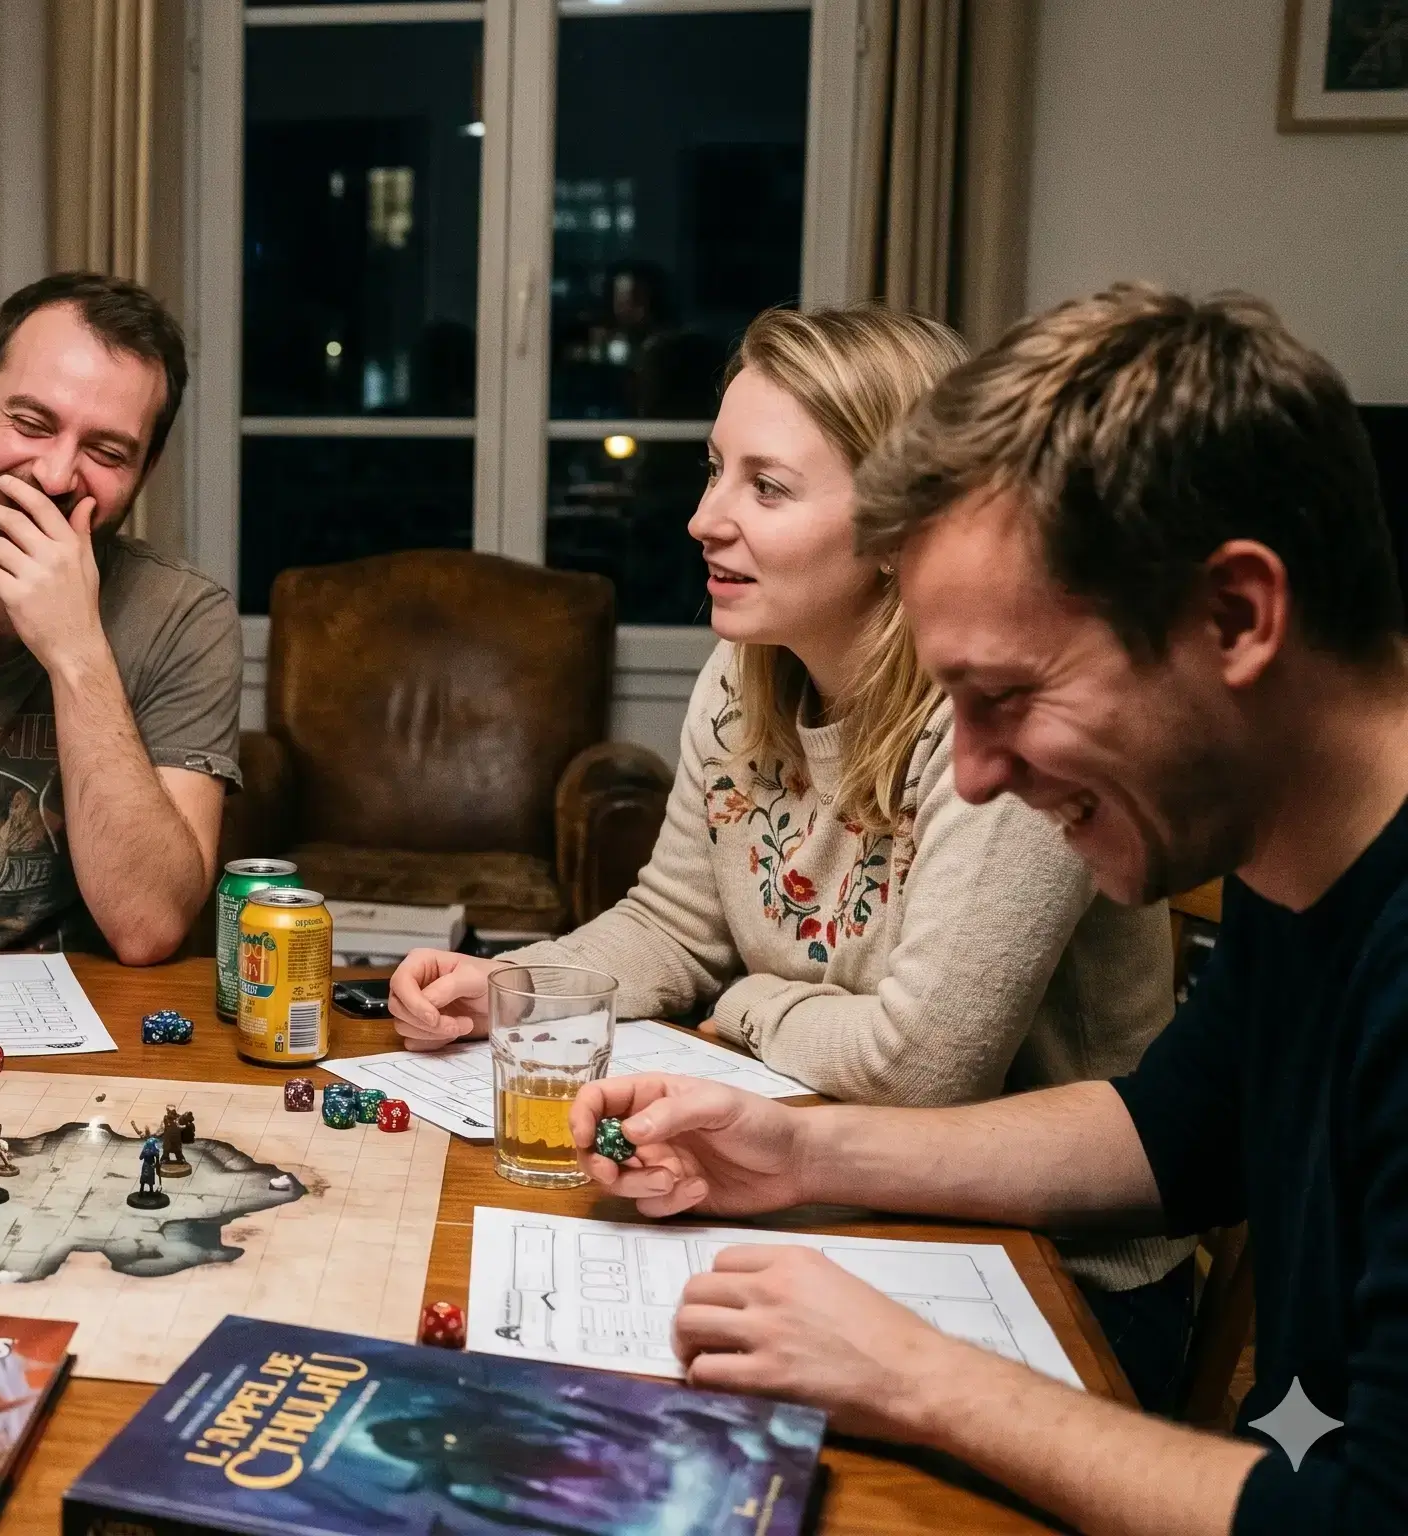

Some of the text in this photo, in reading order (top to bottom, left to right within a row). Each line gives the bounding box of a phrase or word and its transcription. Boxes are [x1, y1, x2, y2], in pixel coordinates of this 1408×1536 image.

[184, 1379, 287, 1467] L'APPEL
[259, 1352, 303, 1377] DE
[224, 1352, 368, 1489] CTHULHU
